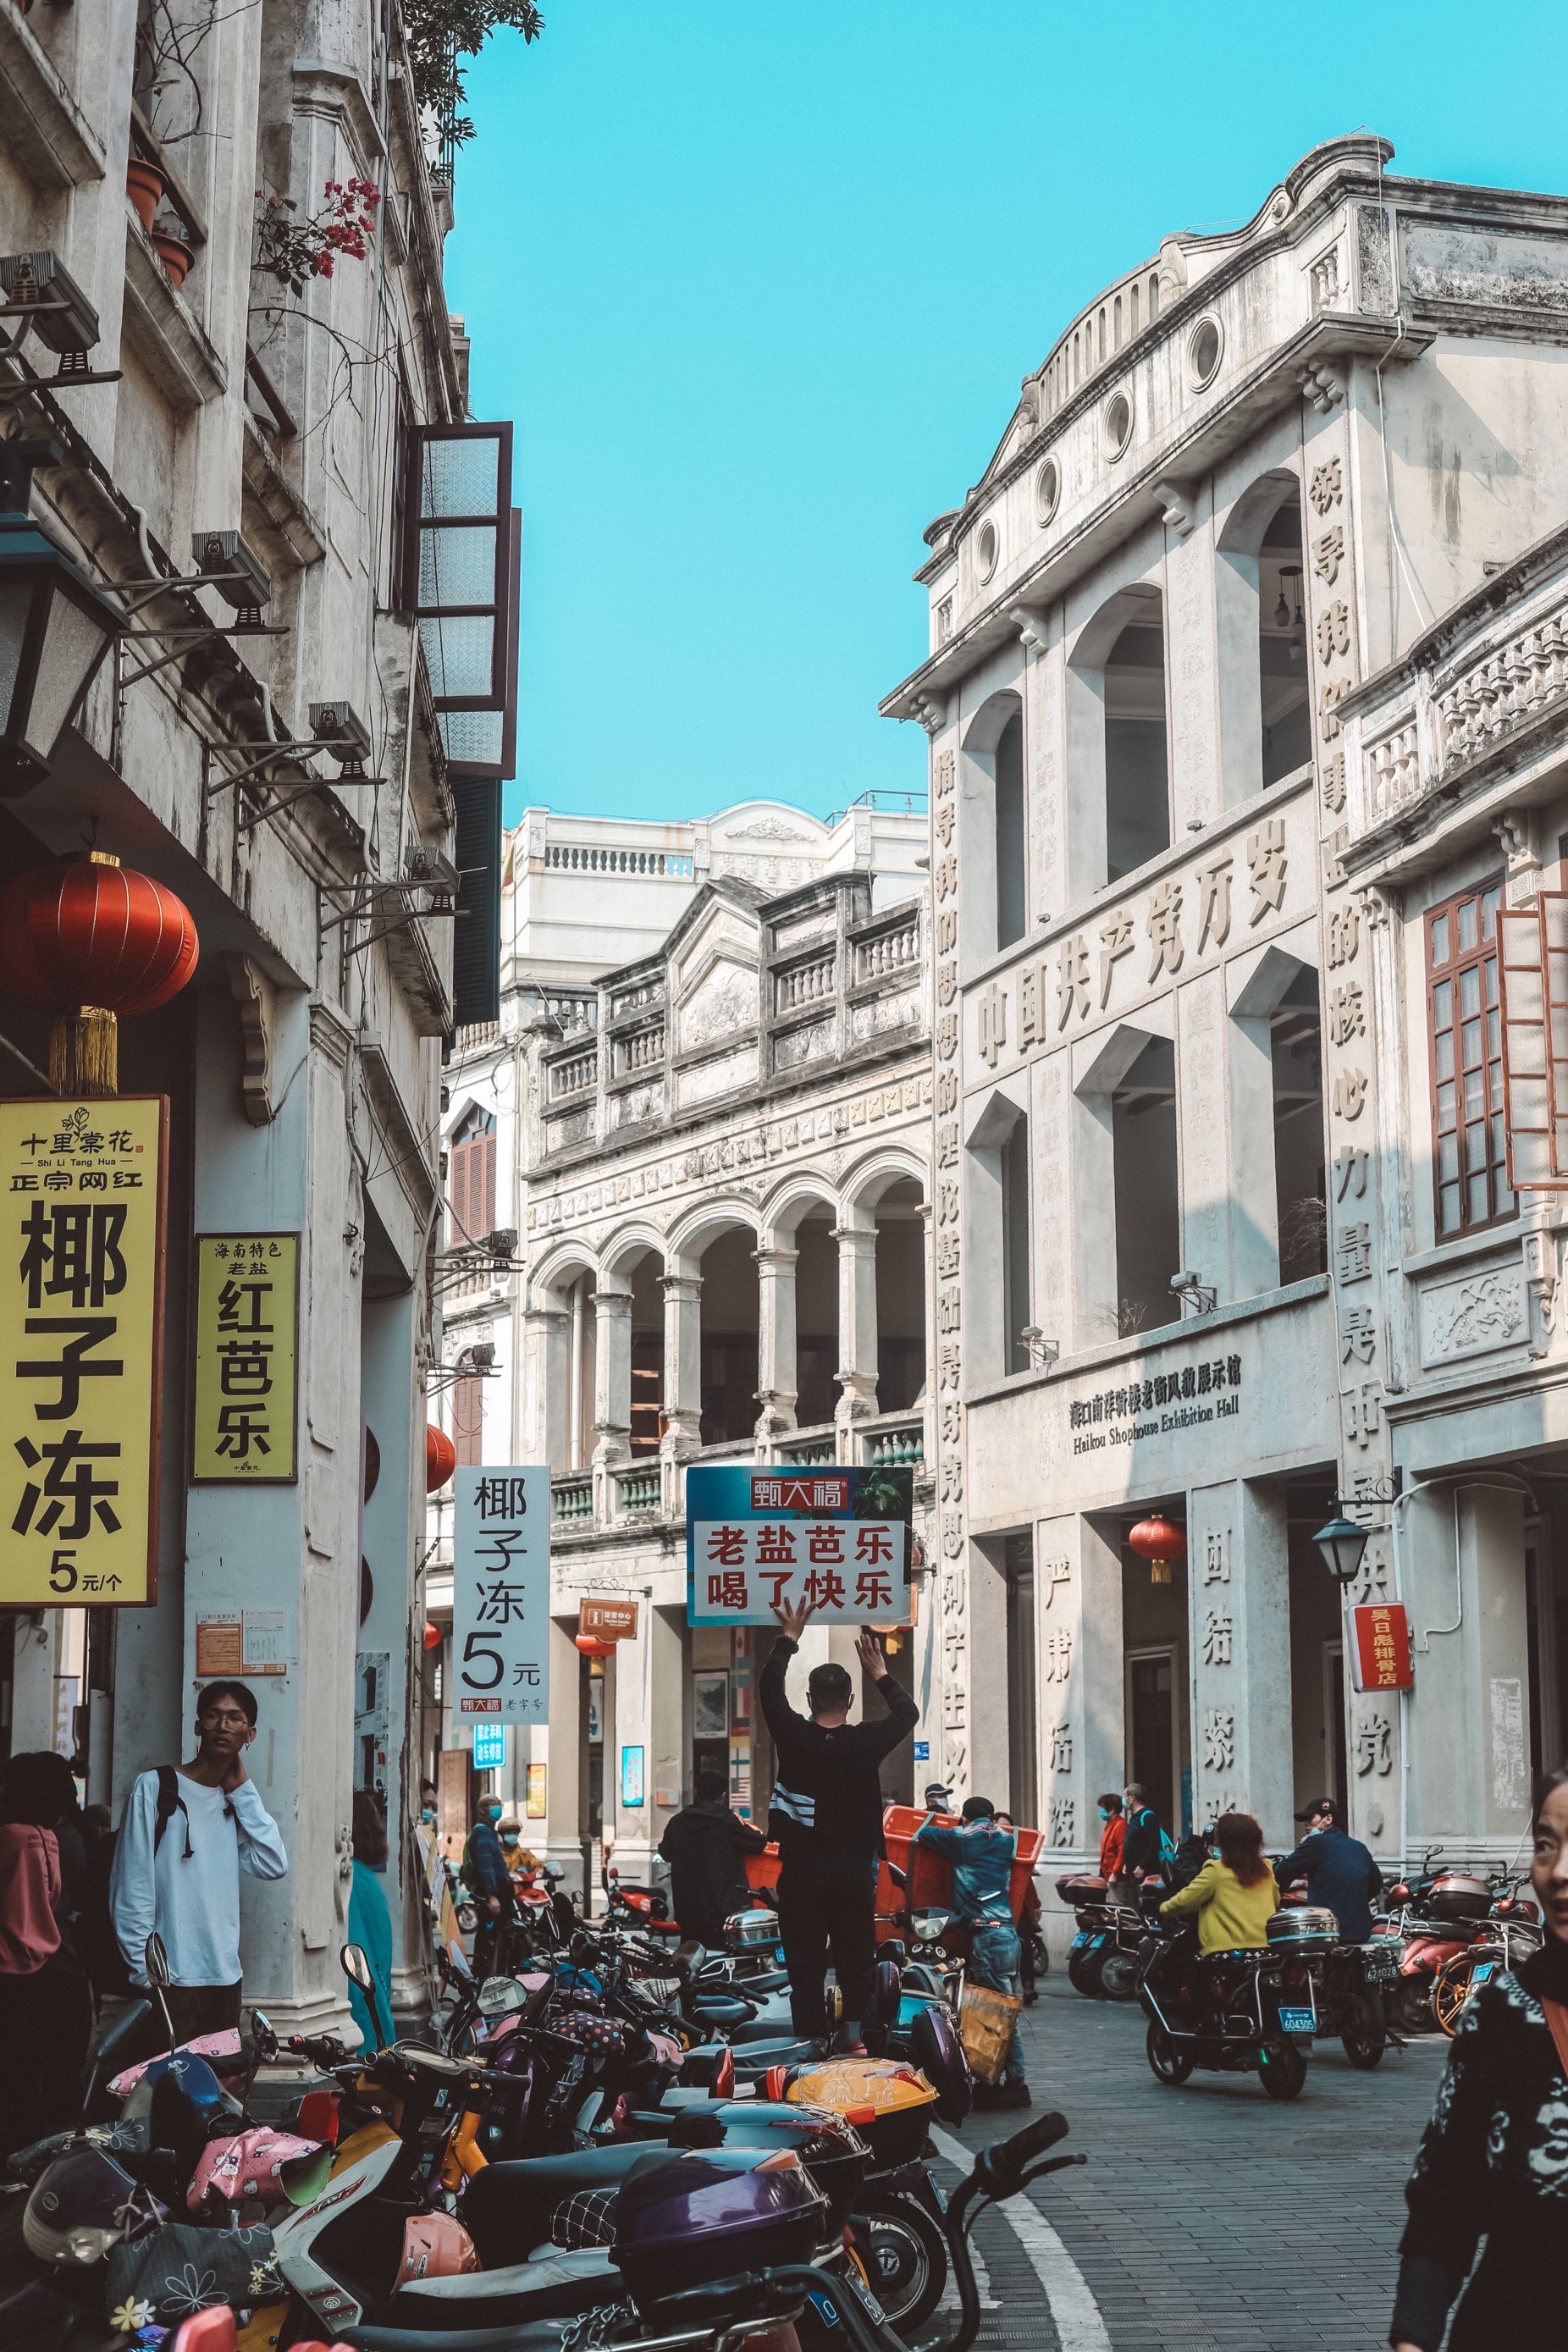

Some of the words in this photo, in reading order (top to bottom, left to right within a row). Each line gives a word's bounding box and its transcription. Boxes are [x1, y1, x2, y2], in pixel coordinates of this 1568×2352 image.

[977, 819, 1286, 1068] 中国共产党万岁
[1309, 454, 1393, 1776] 领导我们事业的核心力量是中国共党
[19, 1129, 134, 1156] 十里棠花
[37, 1159, 52, 1168] Shi
[57, 1158, 65, 1167] Li
[70, 1158, 92, 1168] Tang
[97, 1157, 116, 1166] Hua
[9, 1170, 143, 1192] 正宗网红
[214, 1241, 282, 1260] 海南特色
[227, 1262, 269, 1276] 老盐
[934, 748, 967, 1784] 指导我们思想的理论基础是马克思列宁主义
[12, 1200, 128, 1541] 椰子冻
[214, 1279, 275, 1460] 红芭乐
[1068, 1354, 1242, 1431] 海口南洋骑楼老街风貌展示馆
[1074, 1433, 1107, 1455] Haikou
[1109, 1420, 1160, 1446] Shophouse
[1161, 1403, 1214, 1433] Exhibition
[1216, 1394, 1239, 1418] Hall
[754, 1479, 842, 1508] 甄大福
[473, 1477, 527, 1625] 椰子冻
[706, 1525, 895, 1565] 老盐芭乐
[48, 1549, 123, 1593] 5元/个
[707, 1569, 894, 1610] 喝了快乐
[461, 1631, 541, 1690] 5元
[462, 1698, 501, 1712] 甄大福
[505, 1698, 544, 1712] 老字号
[1045, 1553, 1075, 1848] 严肃活泼
[1367, 1966, 1397, 1979] 624028
[1284, 2019, 1314, 2030] 604305
